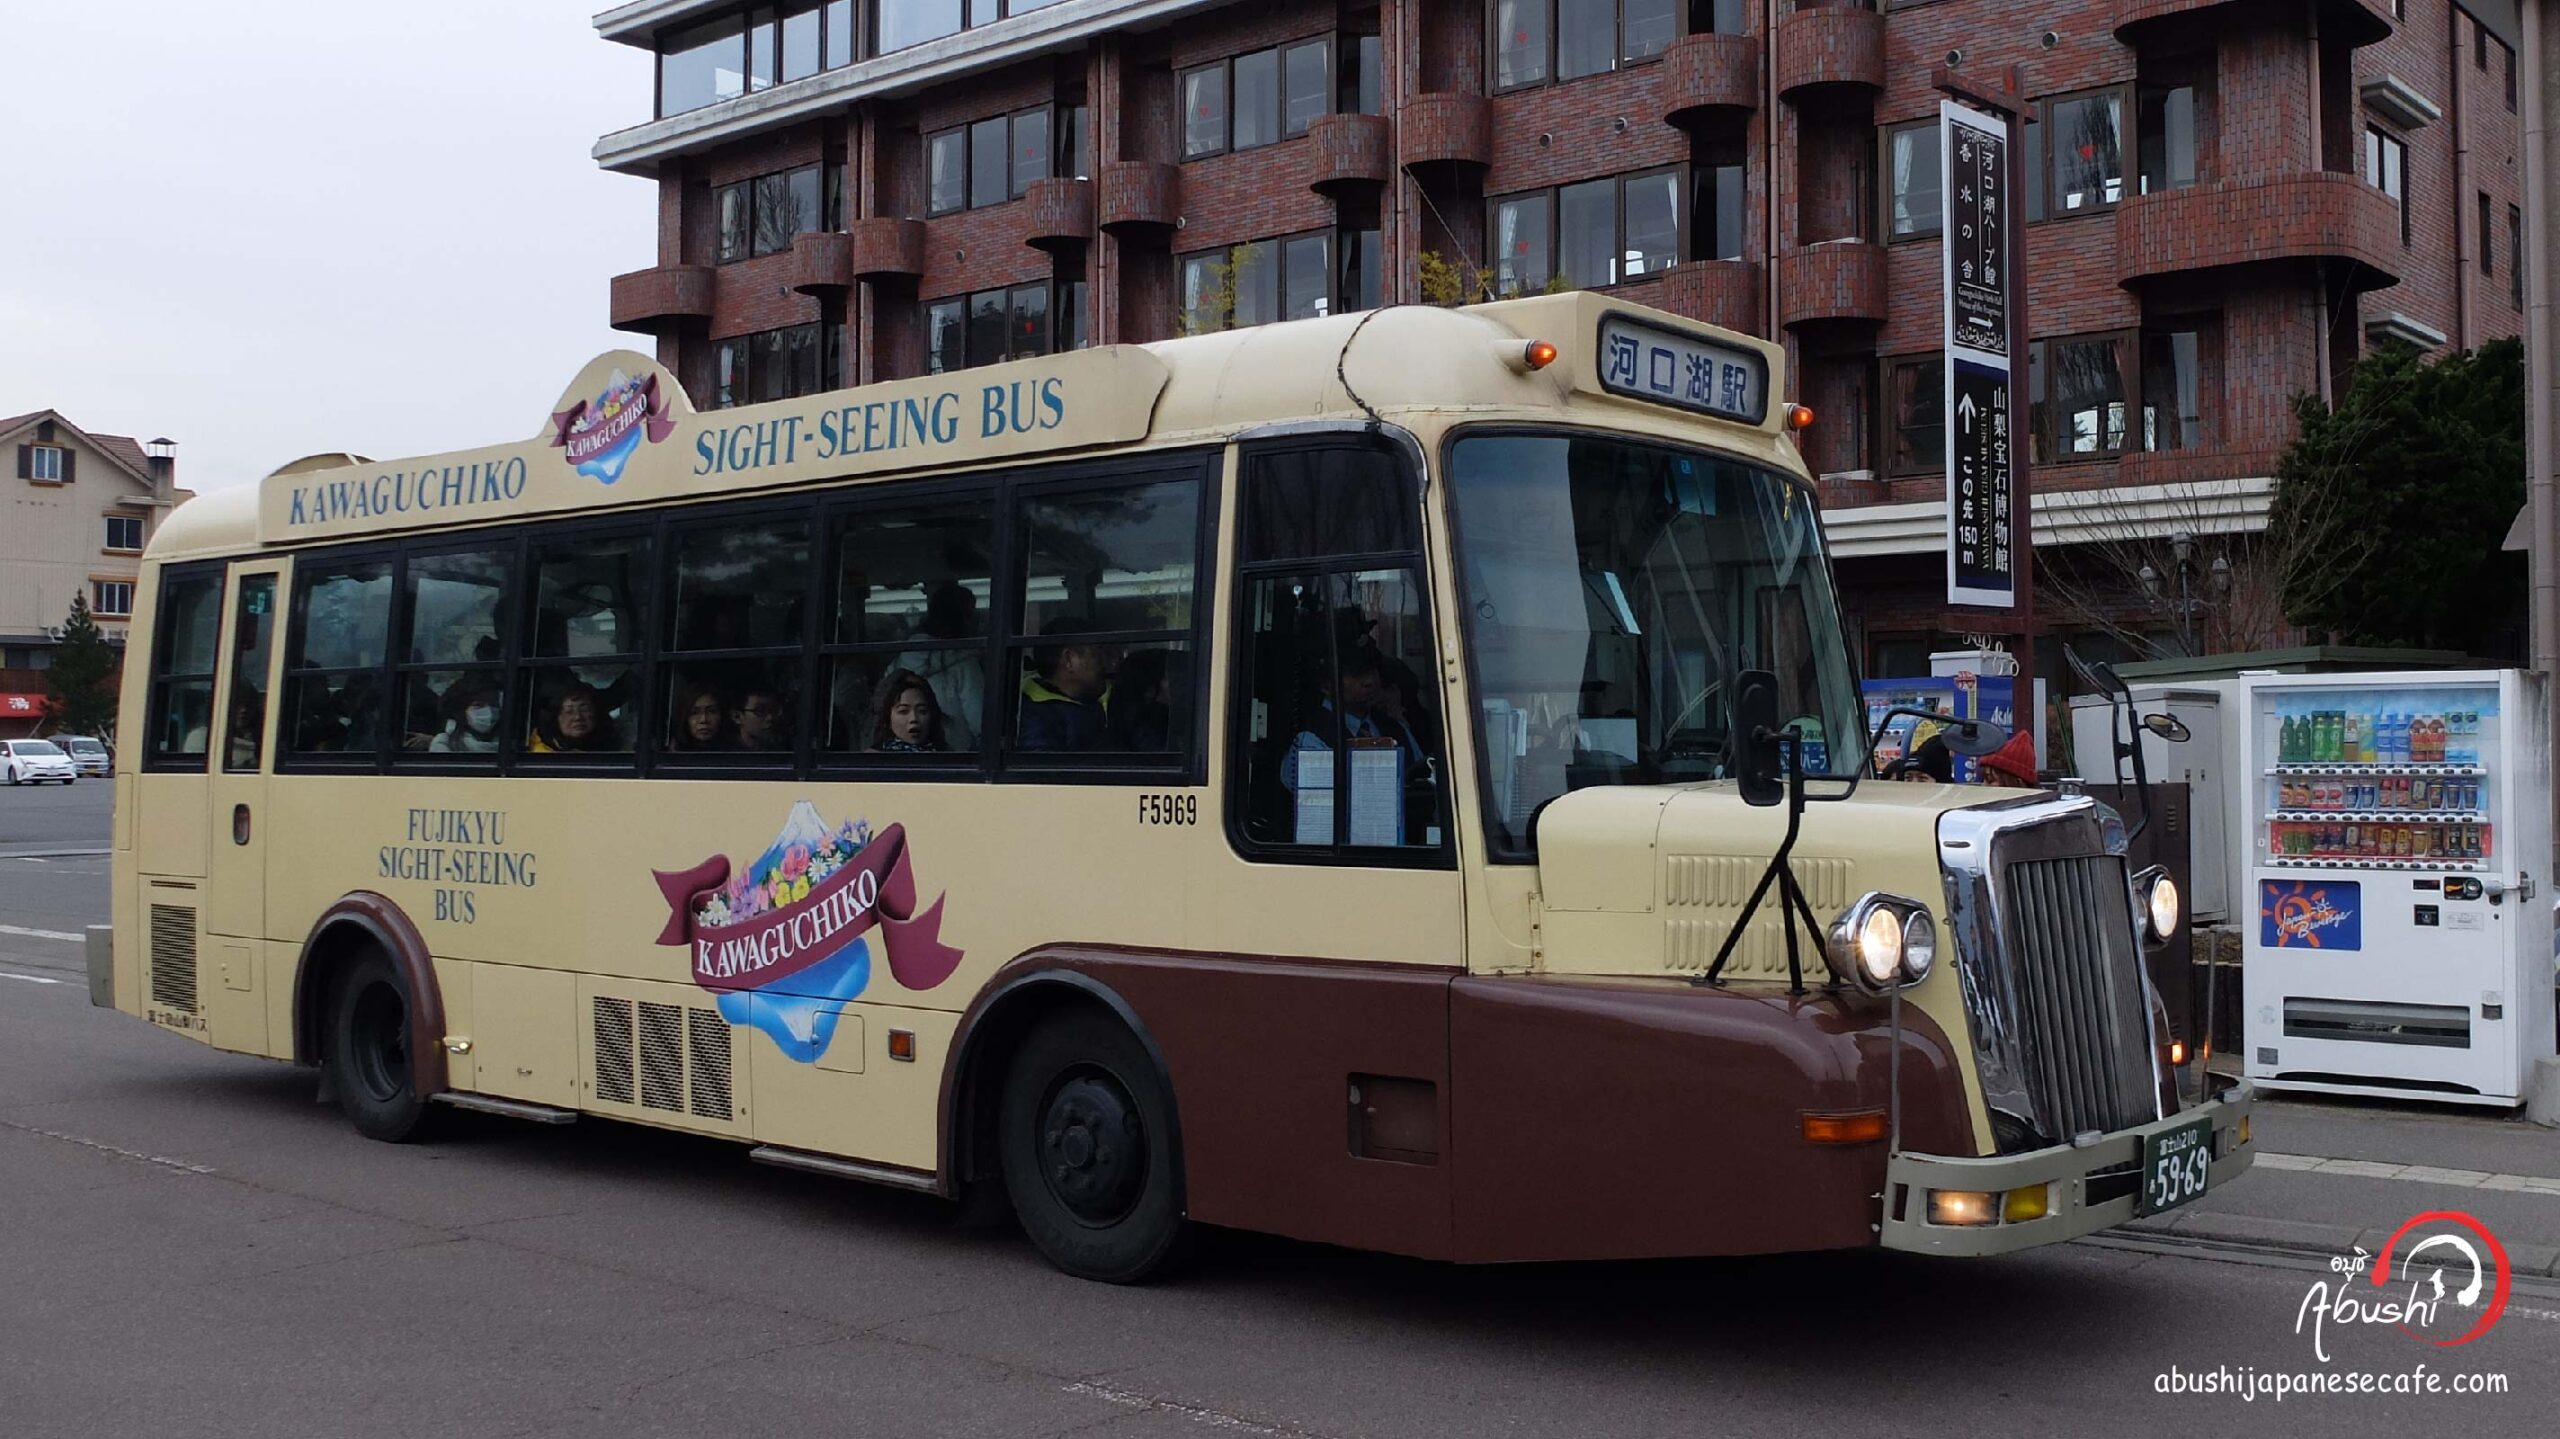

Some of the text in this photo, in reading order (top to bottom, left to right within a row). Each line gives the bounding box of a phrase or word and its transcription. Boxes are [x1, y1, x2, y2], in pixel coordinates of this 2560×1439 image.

[1610, 333, 1747, 413] 河口湖駅
[567, 393, 648, 457] KAWAGUCHIKO
[693, 377, 1064, 476] SIGHT-SEEING BUS
[288, 456, 528, 526] KAWAGUCHIKO
[1993, 387, 2008, 573] 山梨宝石博物館
[408, 808, 507, 845] FUJIKYU
[1139, 794, 1196, 826] F5969
[379, 846, 537, 888] SIGHT-SEEING
[434, 888, 476, 925] BUS
[697, 868, 877, 978] KAWAGUCHIKO
[2156, 1146, 2208, 1207] 59-69
